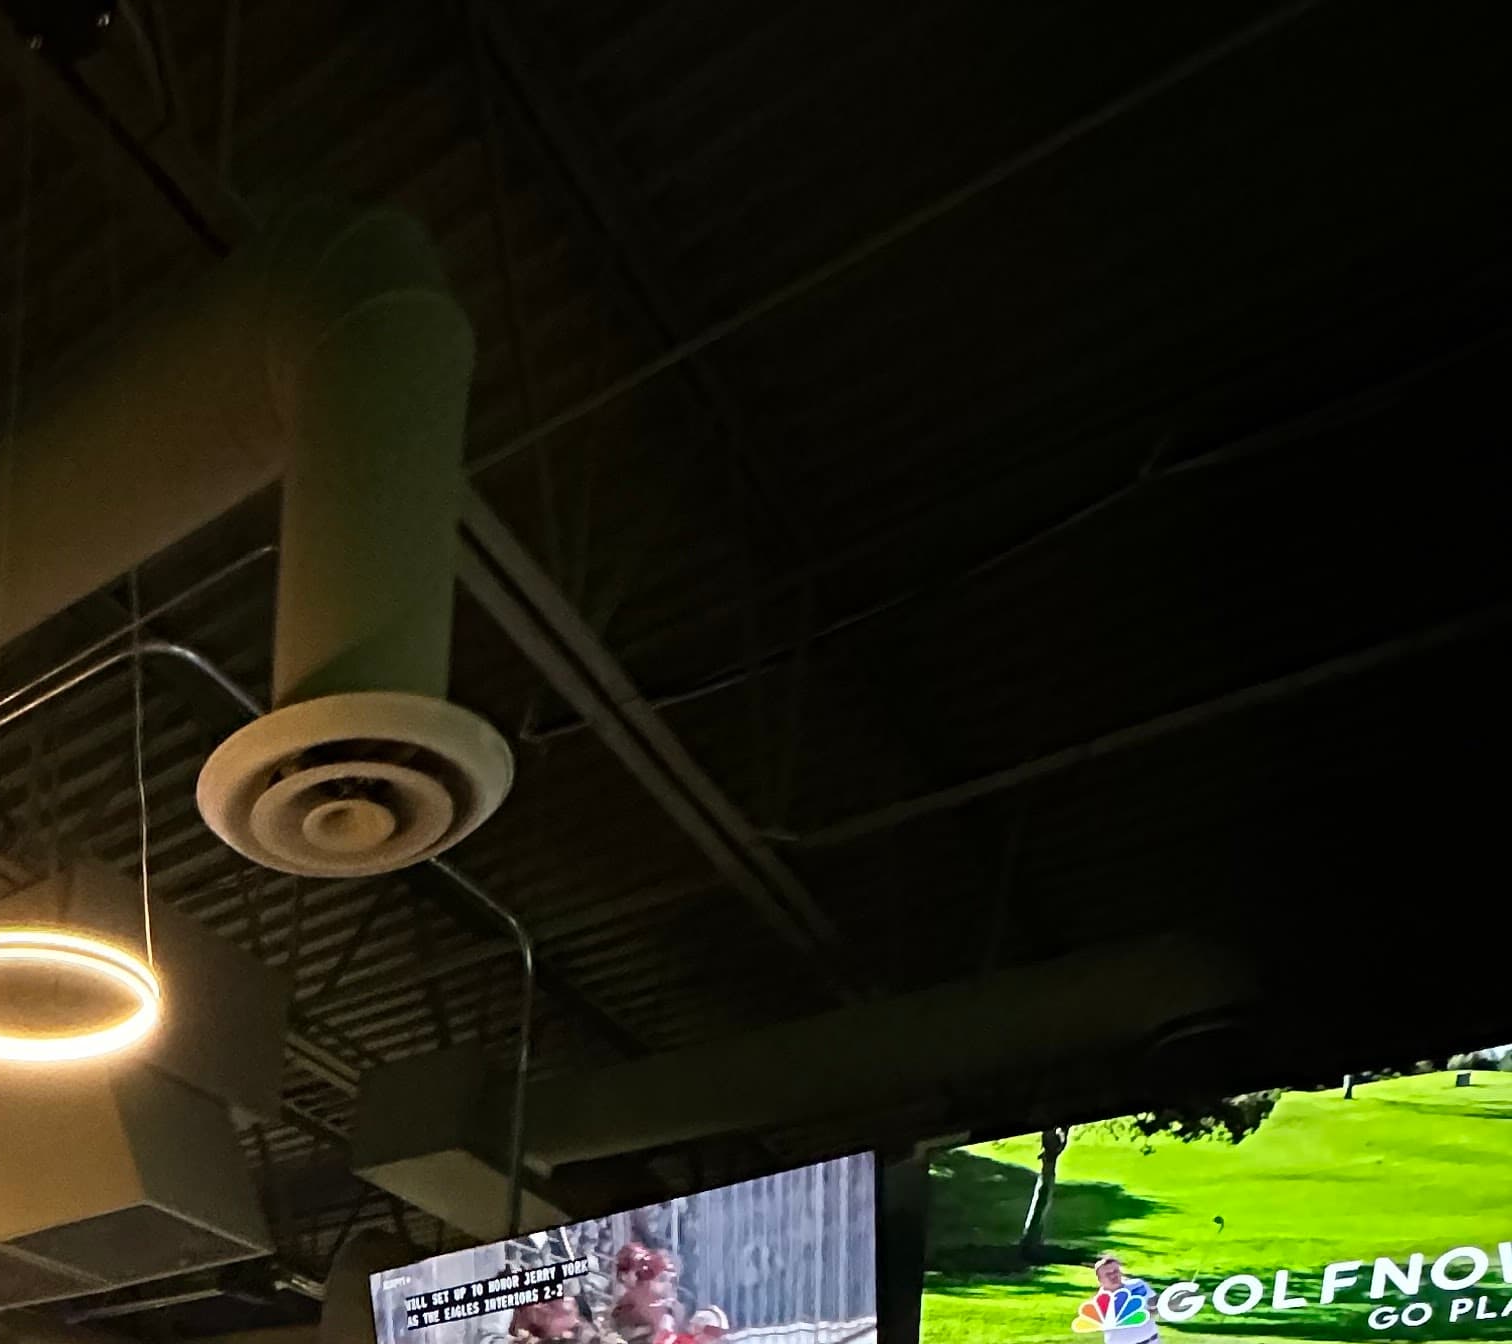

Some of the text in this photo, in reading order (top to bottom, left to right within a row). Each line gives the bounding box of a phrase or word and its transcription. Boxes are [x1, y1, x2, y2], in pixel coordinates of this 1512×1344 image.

[431, 1290, 449, 1306] SET
[453, 1286, 467, 1301] UP
[470, 1282, 484, 1297] TO
[523, 1266, 556, 1286] JERRY
[561, 1259, 588, 1277] YORK
[1156, 1241, 1512, 1323] GOLFNO
[422, 1309, 440, 1325] THE
[444, 1301, 480, 1320] EAGLES
[1367, 1301, 1433, 1330] GO
